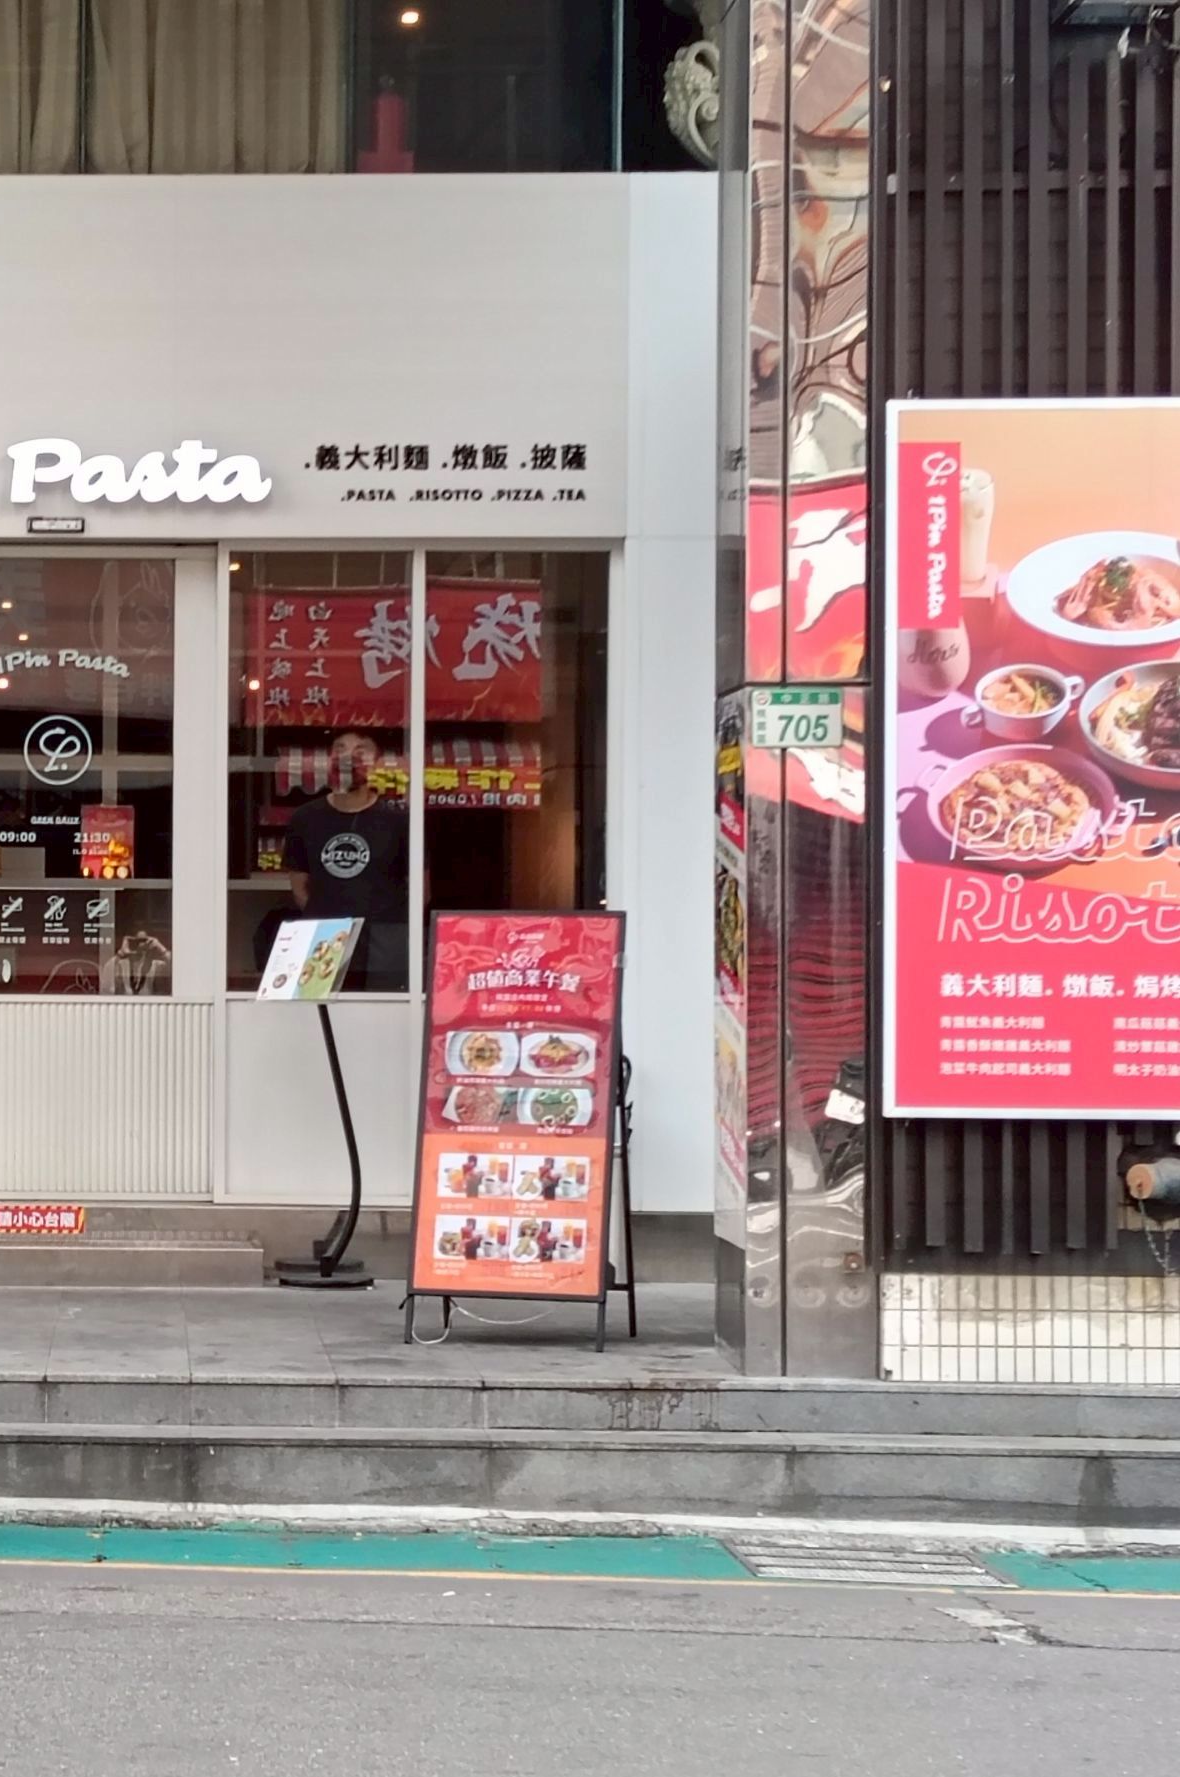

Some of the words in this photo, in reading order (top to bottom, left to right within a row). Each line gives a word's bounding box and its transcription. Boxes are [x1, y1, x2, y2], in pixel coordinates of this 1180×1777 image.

[7, 438, 272, 503] Pasta
[927, 553, 946, 619] Pasta
[58, 649, 130, 678] Pasta
[777, 715, 829, 742] 705
[0, 831, 37, 843] 09:00
